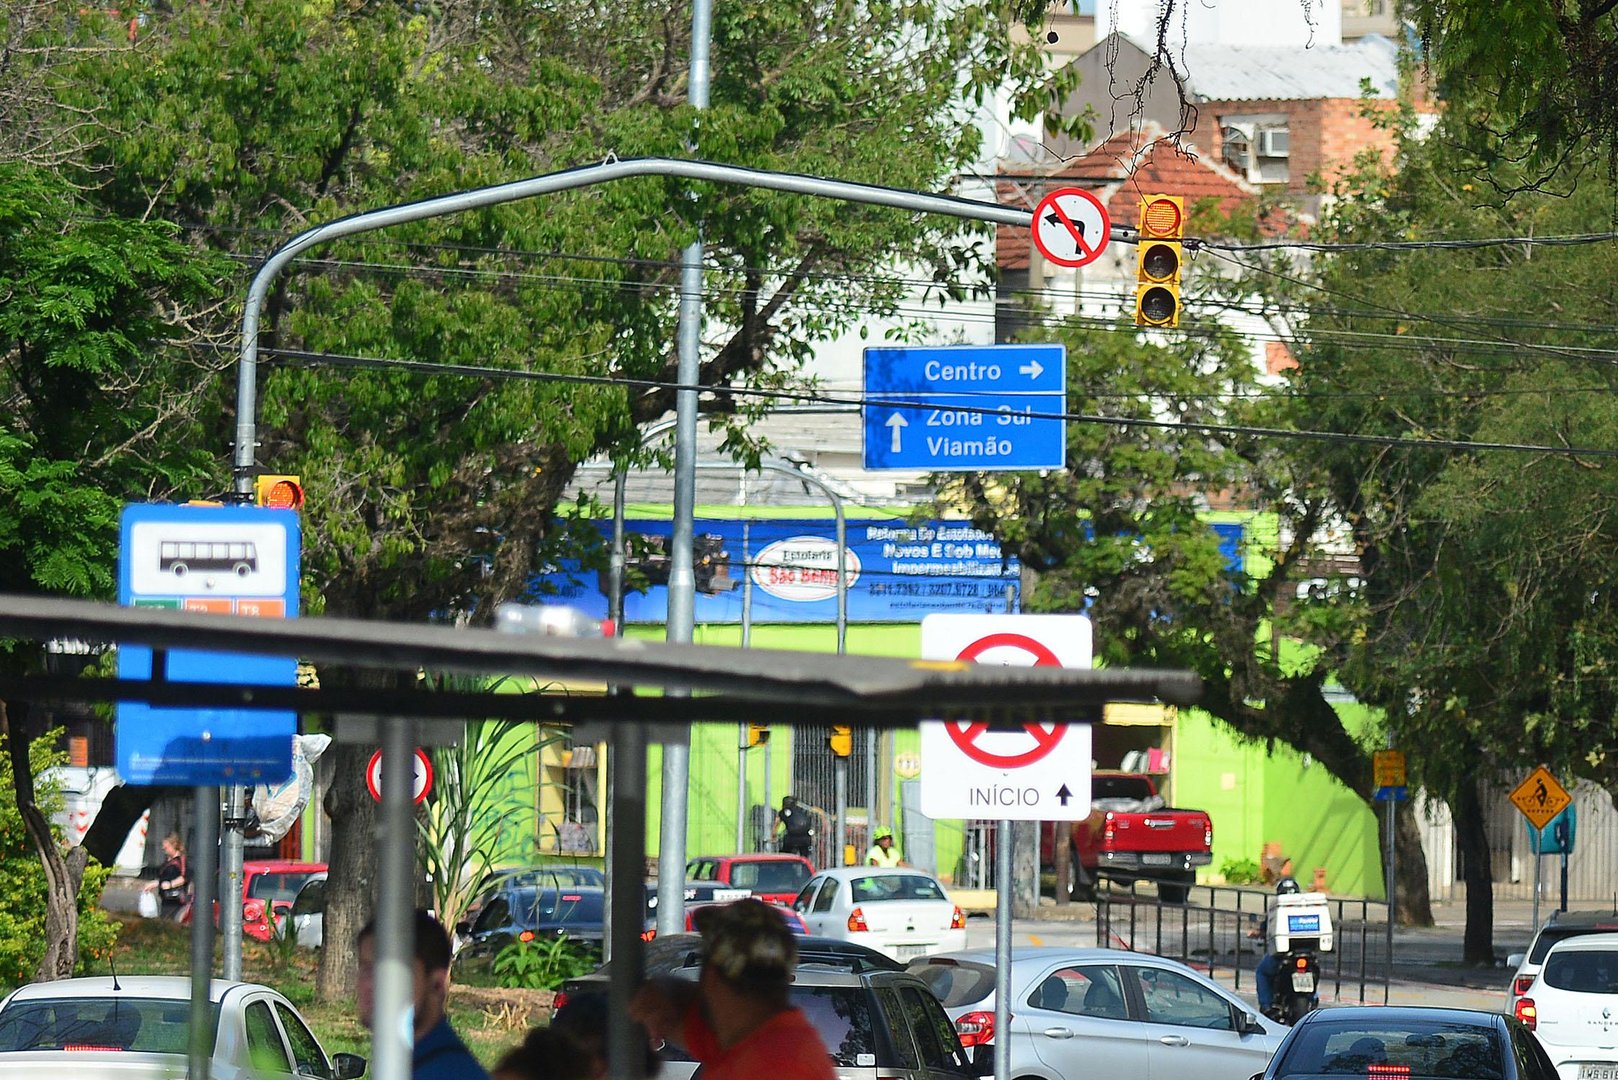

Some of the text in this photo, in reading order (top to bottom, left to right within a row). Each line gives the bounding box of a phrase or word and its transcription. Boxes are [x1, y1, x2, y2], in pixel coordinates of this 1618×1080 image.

[924, 360, 1001, 381] Centro
[926, 405, 1031, 426] Zona Sul
[926, 436, 1013, 457] Viamão
[883, 543, 929, 558] Novos
[944, 543, 974, 559] Sob
[970, 784, 1039, 806] INÍCIO
